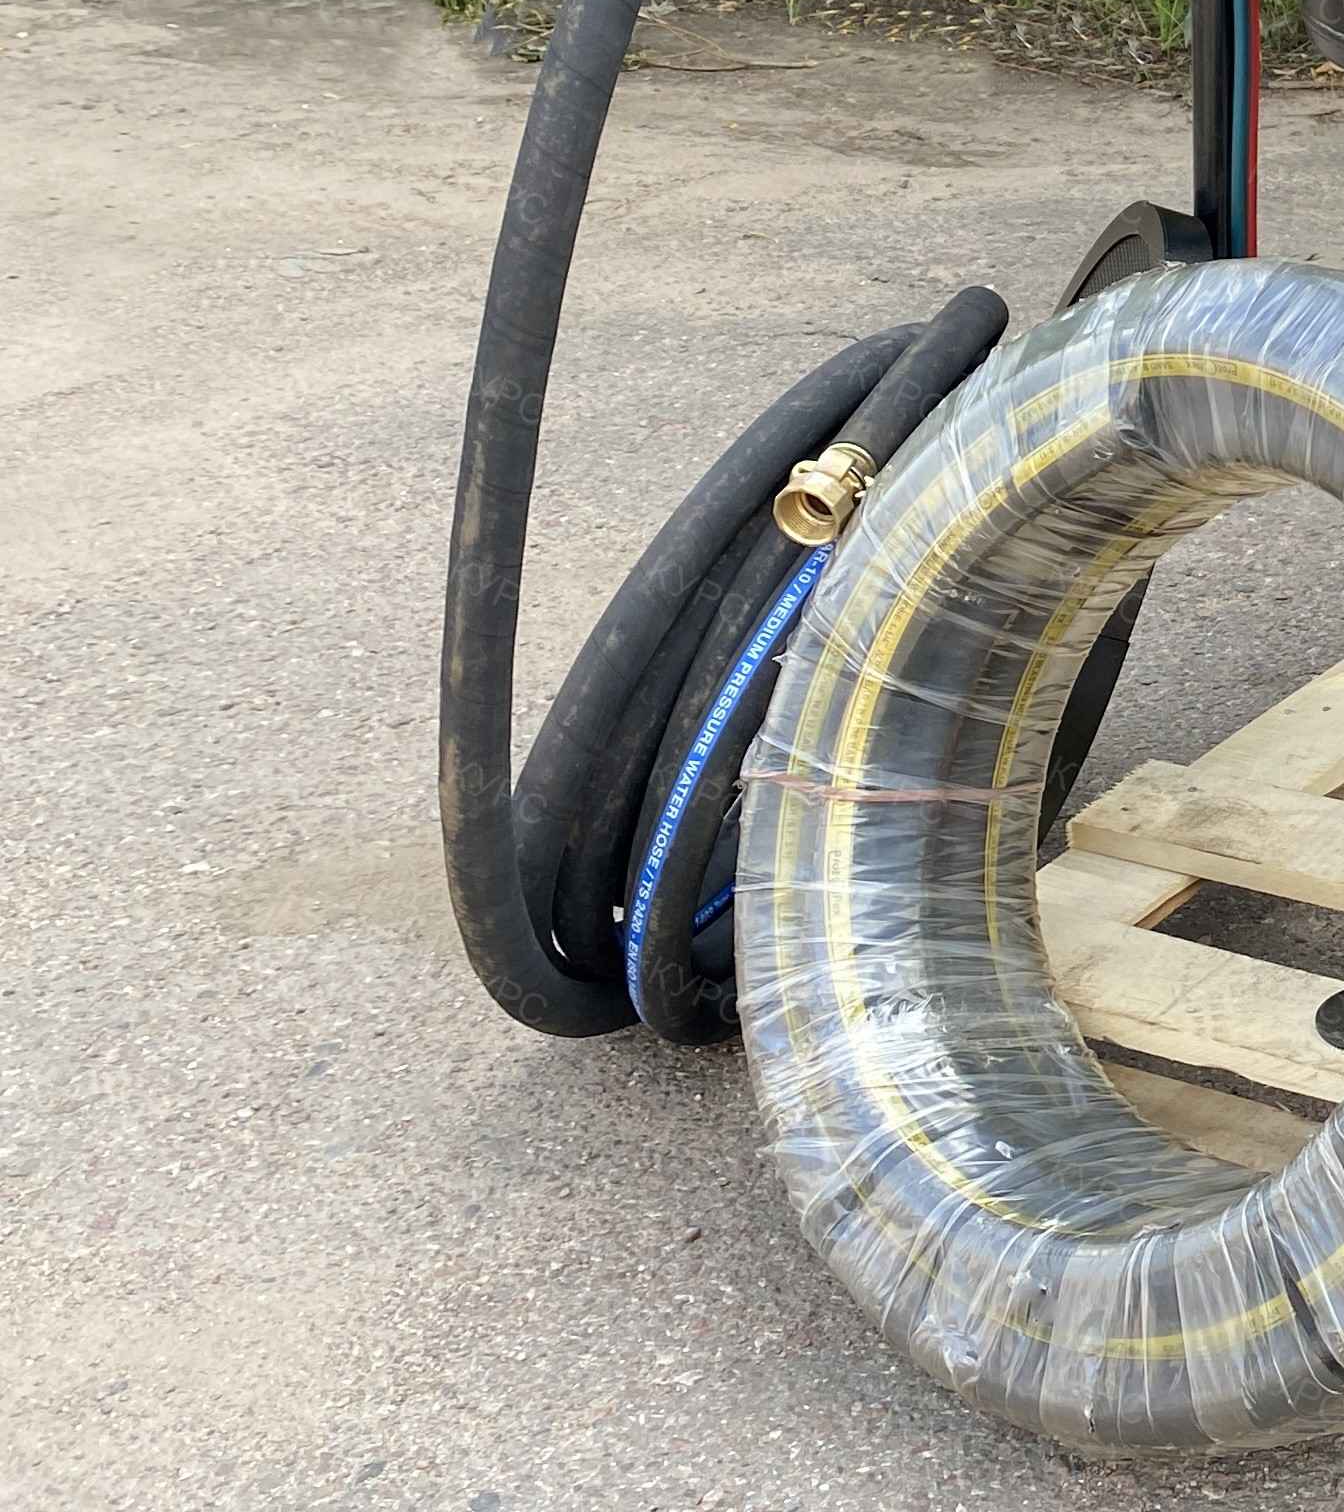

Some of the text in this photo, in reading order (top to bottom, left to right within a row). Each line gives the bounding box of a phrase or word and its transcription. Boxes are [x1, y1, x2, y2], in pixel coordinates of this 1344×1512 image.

[747, 593, 798, 660] MEDIUM
[693, 662, 752, 757] PRESSURE
[666, 759, 700, 819] WATER
[648, 821, 674, 872] HOSE
[638, 879, 654, 901] TS
